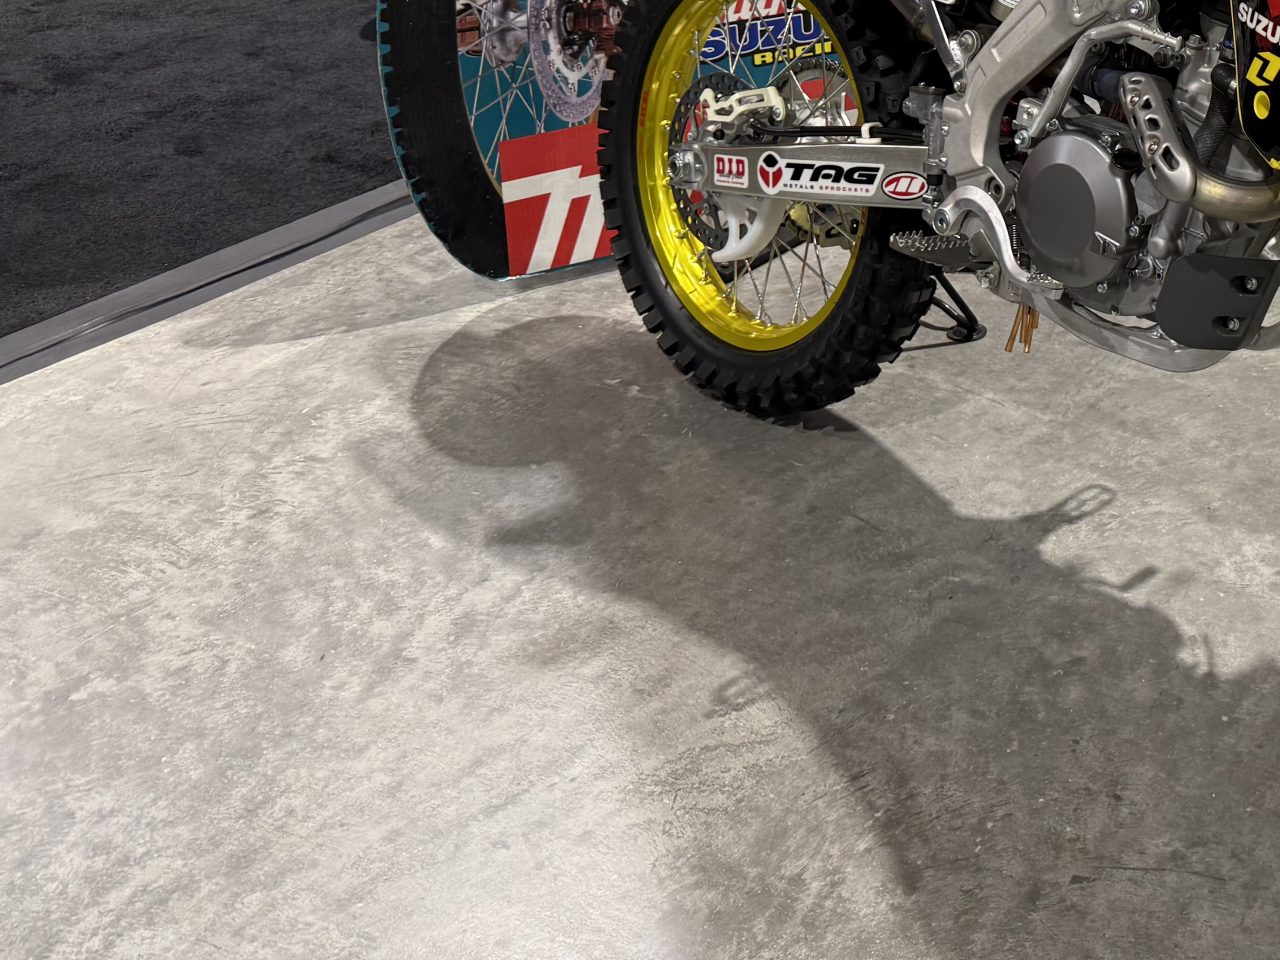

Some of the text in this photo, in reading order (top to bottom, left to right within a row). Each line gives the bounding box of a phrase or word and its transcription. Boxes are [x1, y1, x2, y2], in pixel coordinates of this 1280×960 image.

[784, 163, 880, 185] TAG
[783, 182, 870, 193] METALS SPROCKETS
